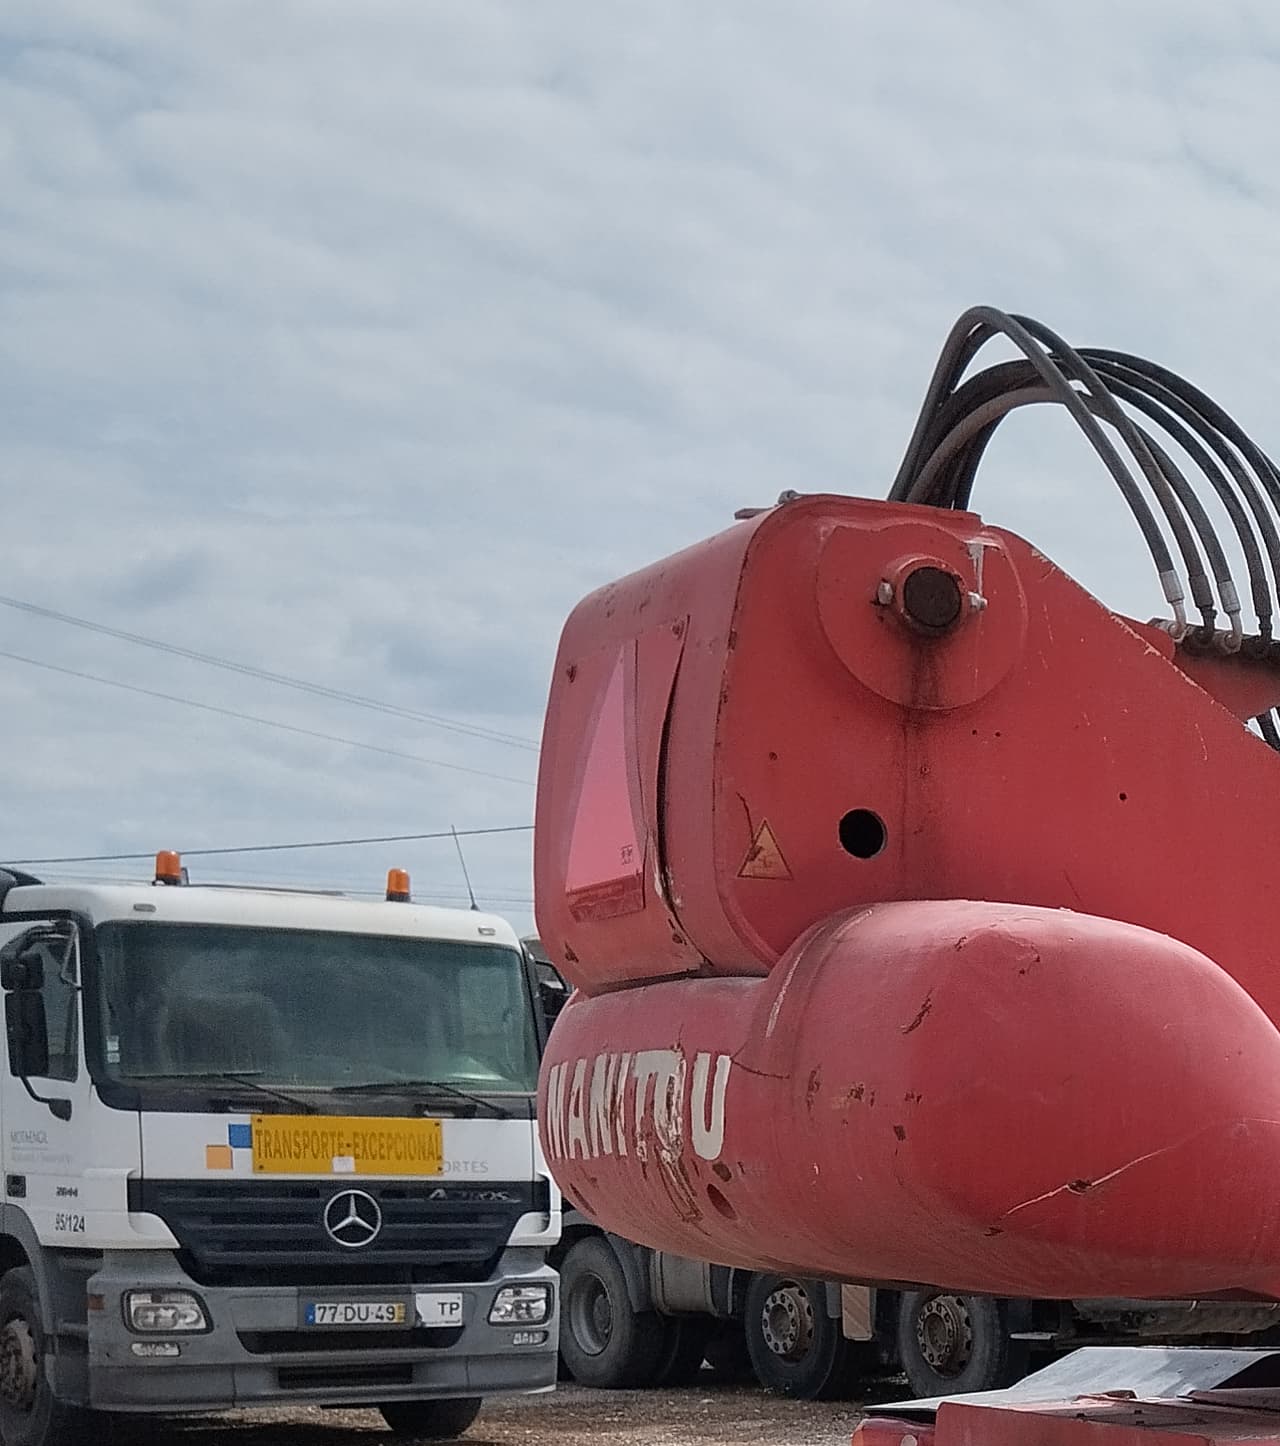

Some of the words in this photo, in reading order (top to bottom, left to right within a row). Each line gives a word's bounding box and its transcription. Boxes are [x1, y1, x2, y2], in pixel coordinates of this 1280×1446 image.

[547, 1049, 732, 1164] MANITOU
[256, 1129, 345, 1160] TRANSPORTE
[352, 1131, 442, 1161] EXCEPCIONAL
[437, 1301, 460, 1316] TP
